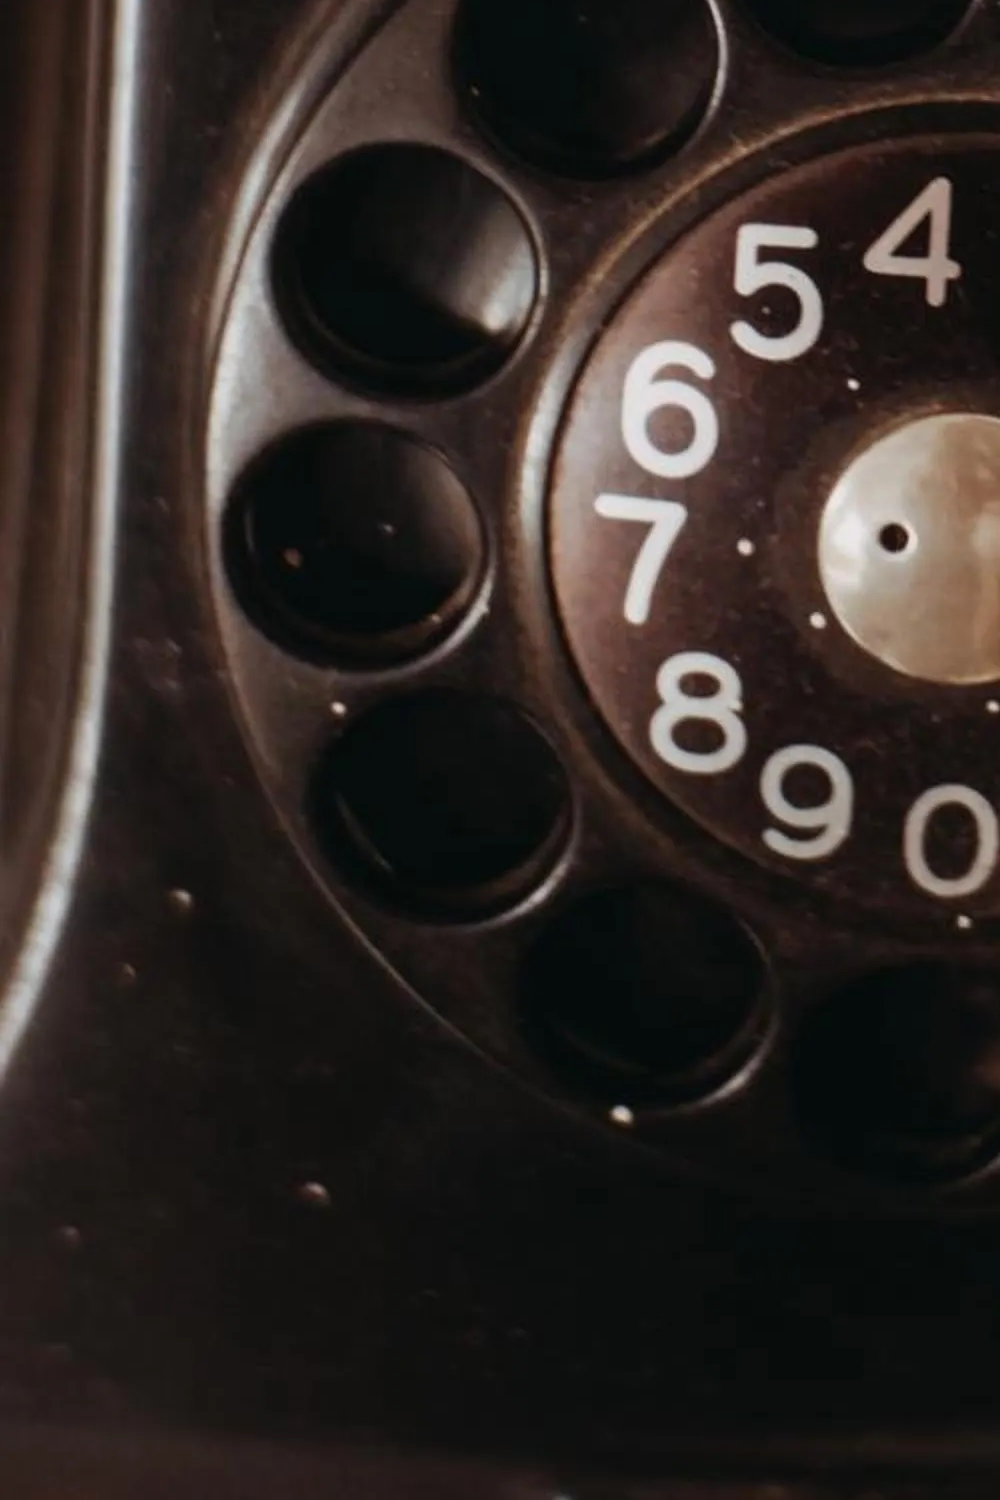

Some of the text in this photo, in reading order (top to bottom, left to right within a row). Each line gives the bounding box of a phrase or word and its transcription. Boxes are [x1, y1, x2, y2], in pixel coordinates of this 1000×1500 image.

[730, 223, 824, 362] 5
[862, 176, 961, 308] 4
[621, 340, 719, 478] 6
[594, 494, 688, 625] 7
[648, 651, 747, 775] 8
[759, 744, 854, 860] 9
[903, 783, 1000, 899] 0
